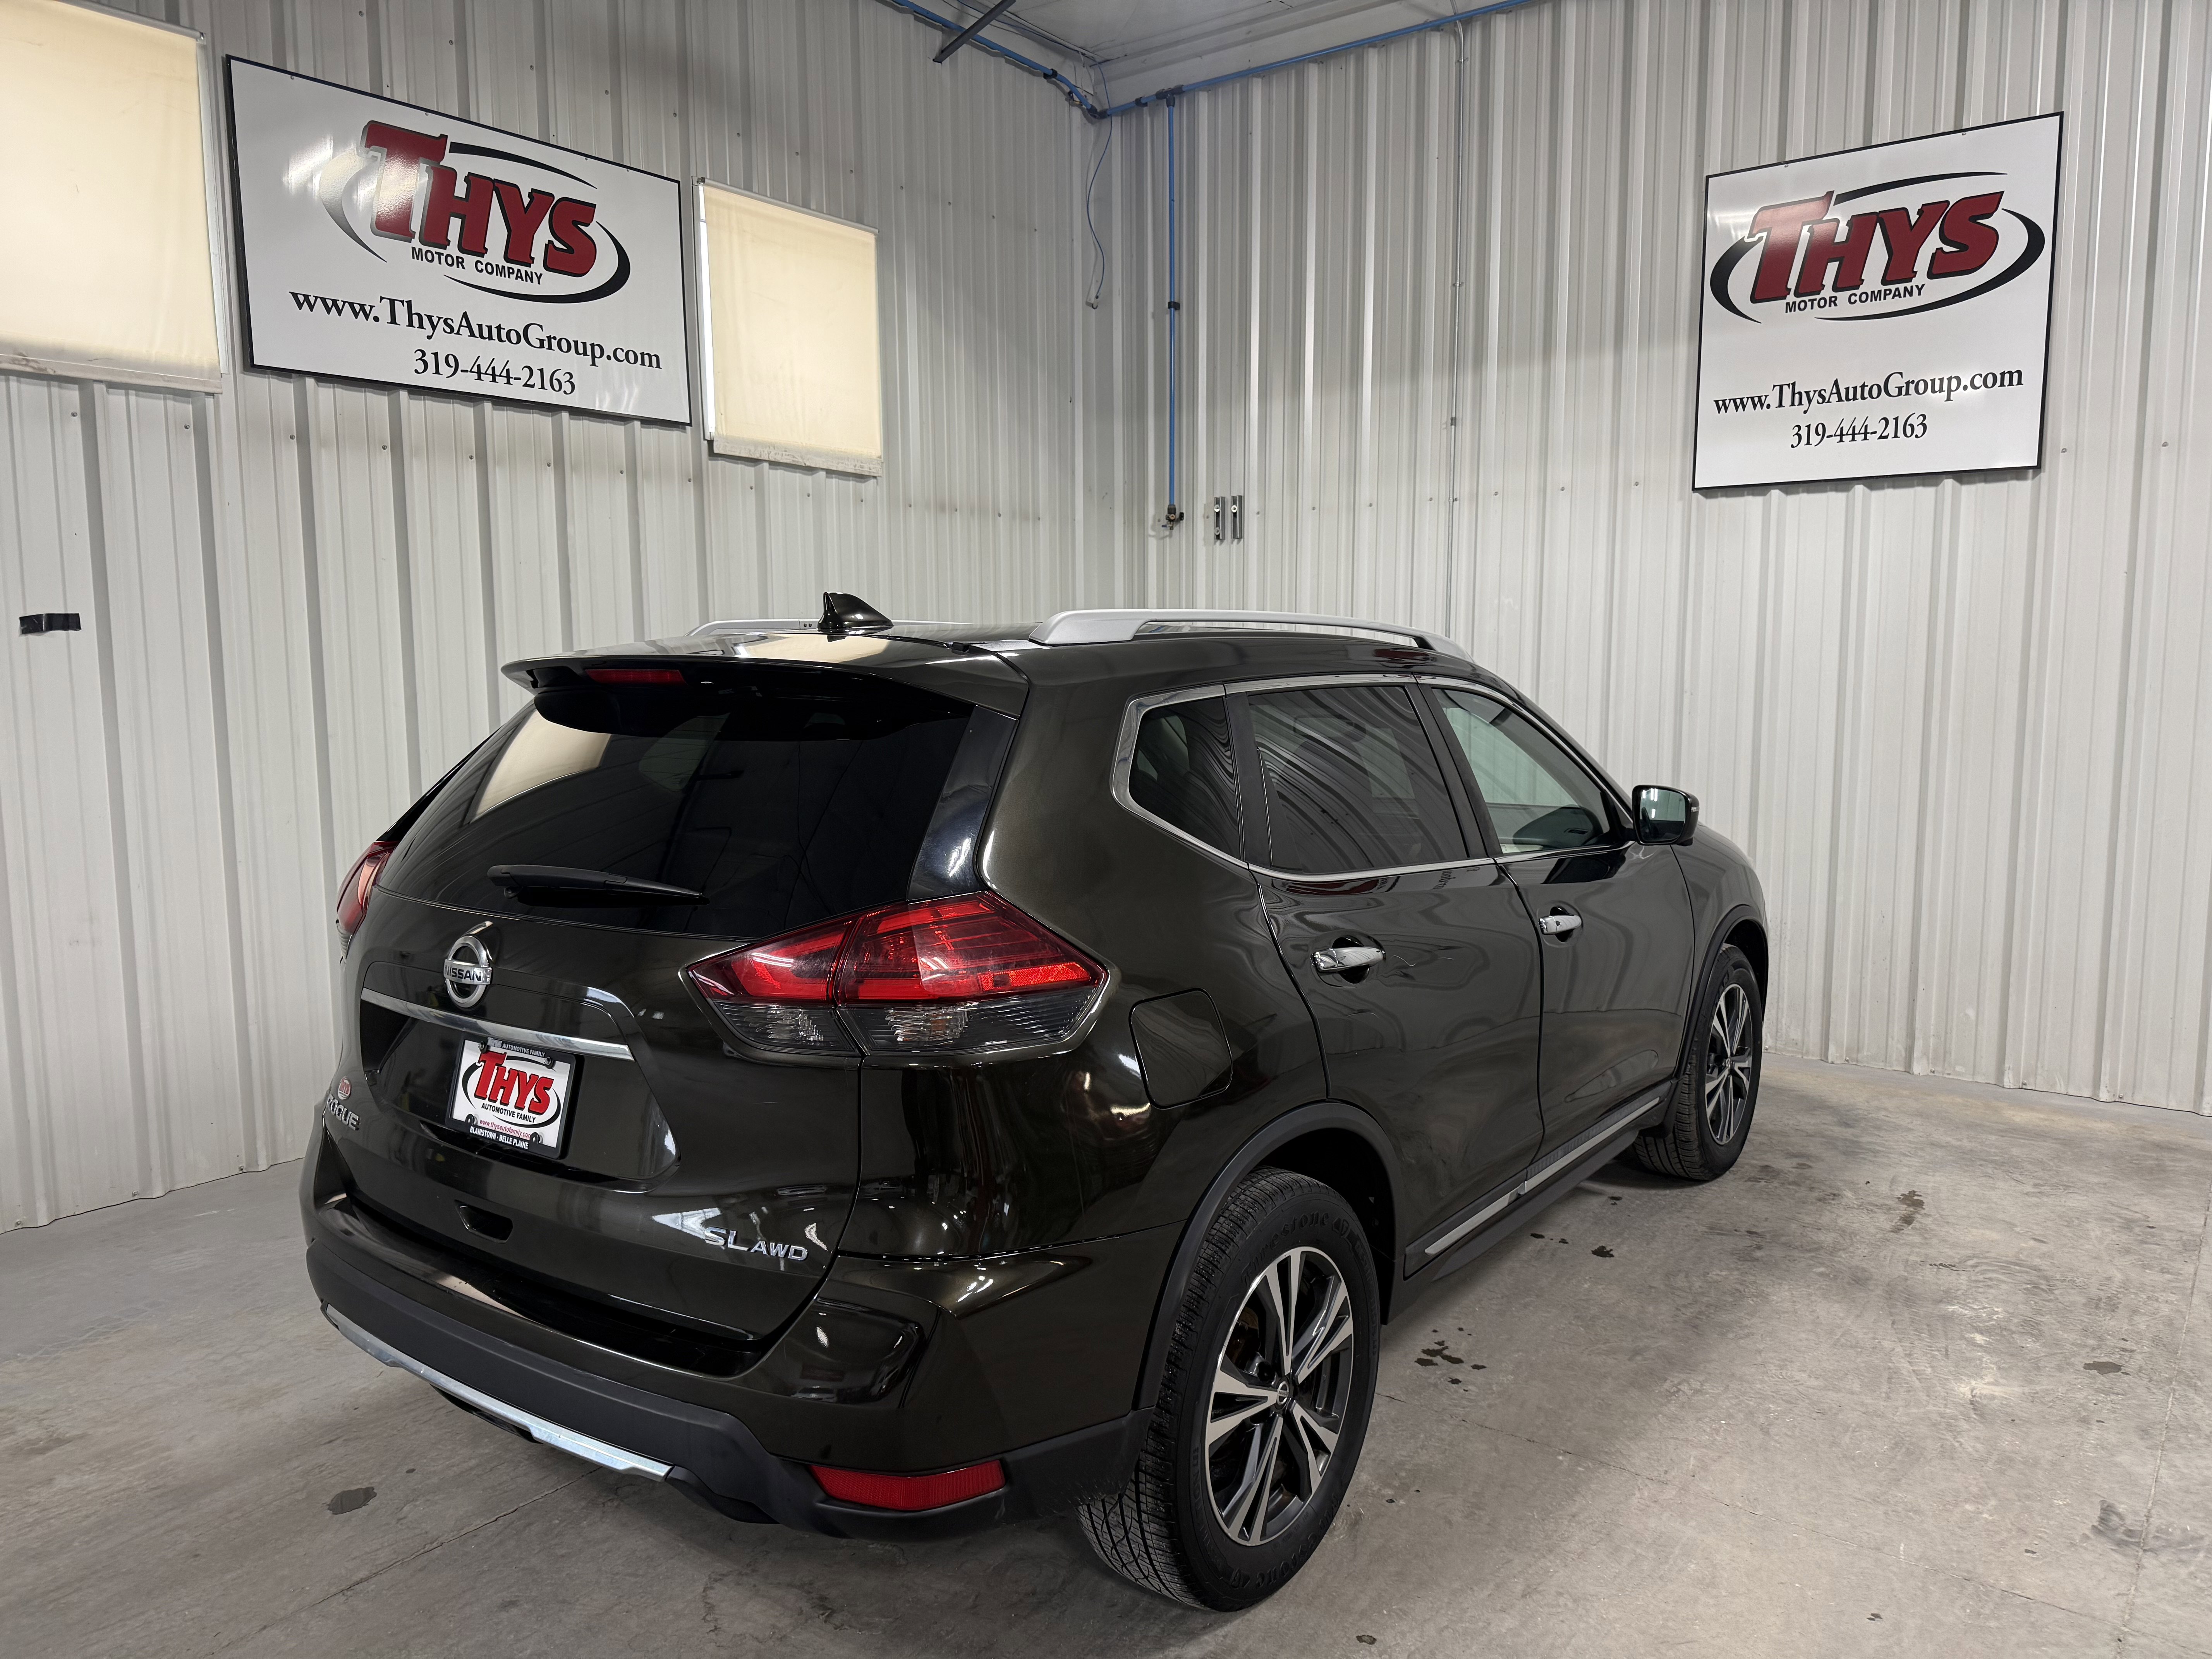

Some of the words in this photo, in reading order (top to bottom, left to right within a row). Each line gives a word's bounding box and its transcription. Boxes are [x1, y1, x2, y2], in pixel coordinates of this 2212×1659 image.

[359, 119, 597, 278] THYS
[1748, 190, 2005, 304] THYS
[411, 246, 465, 270] MOTOR
[474, 260, 543, 285] COMPANY
[1784, 295, 1838, 313] MOTOR
[1848, 283, 1926, 305] COMPANY
[289, 291, 662, 369] www.ThysAutoGroup.com
[414, 349, 575, 395] 319-444-2163
[1713, 369, 2023, 414] www.ThysAutoGroup.com
[1790, 413, 1927, 448] 319-444-2163
[445, 965, 481, 981] NISSAN
[502, 1043, 529, 1054] AUTOMOTIVE
[474, 1051, 554, 1115] THYS
[327, 1094, 361, 1130] ROGUE
[481, 1103, 515, 1118] AUTOMOTIVE
[517, 1113, 536, 1123] FAMILY
[470, 1126, 496, 1140] BLAIRSTOWN
[499, 1135, 512, 1145] BELLE
[513, 1139, 529, 1149] PLAINE
[704, 1226, 749, 1251] SL
[750, 1240, 808, 1261] AWD
